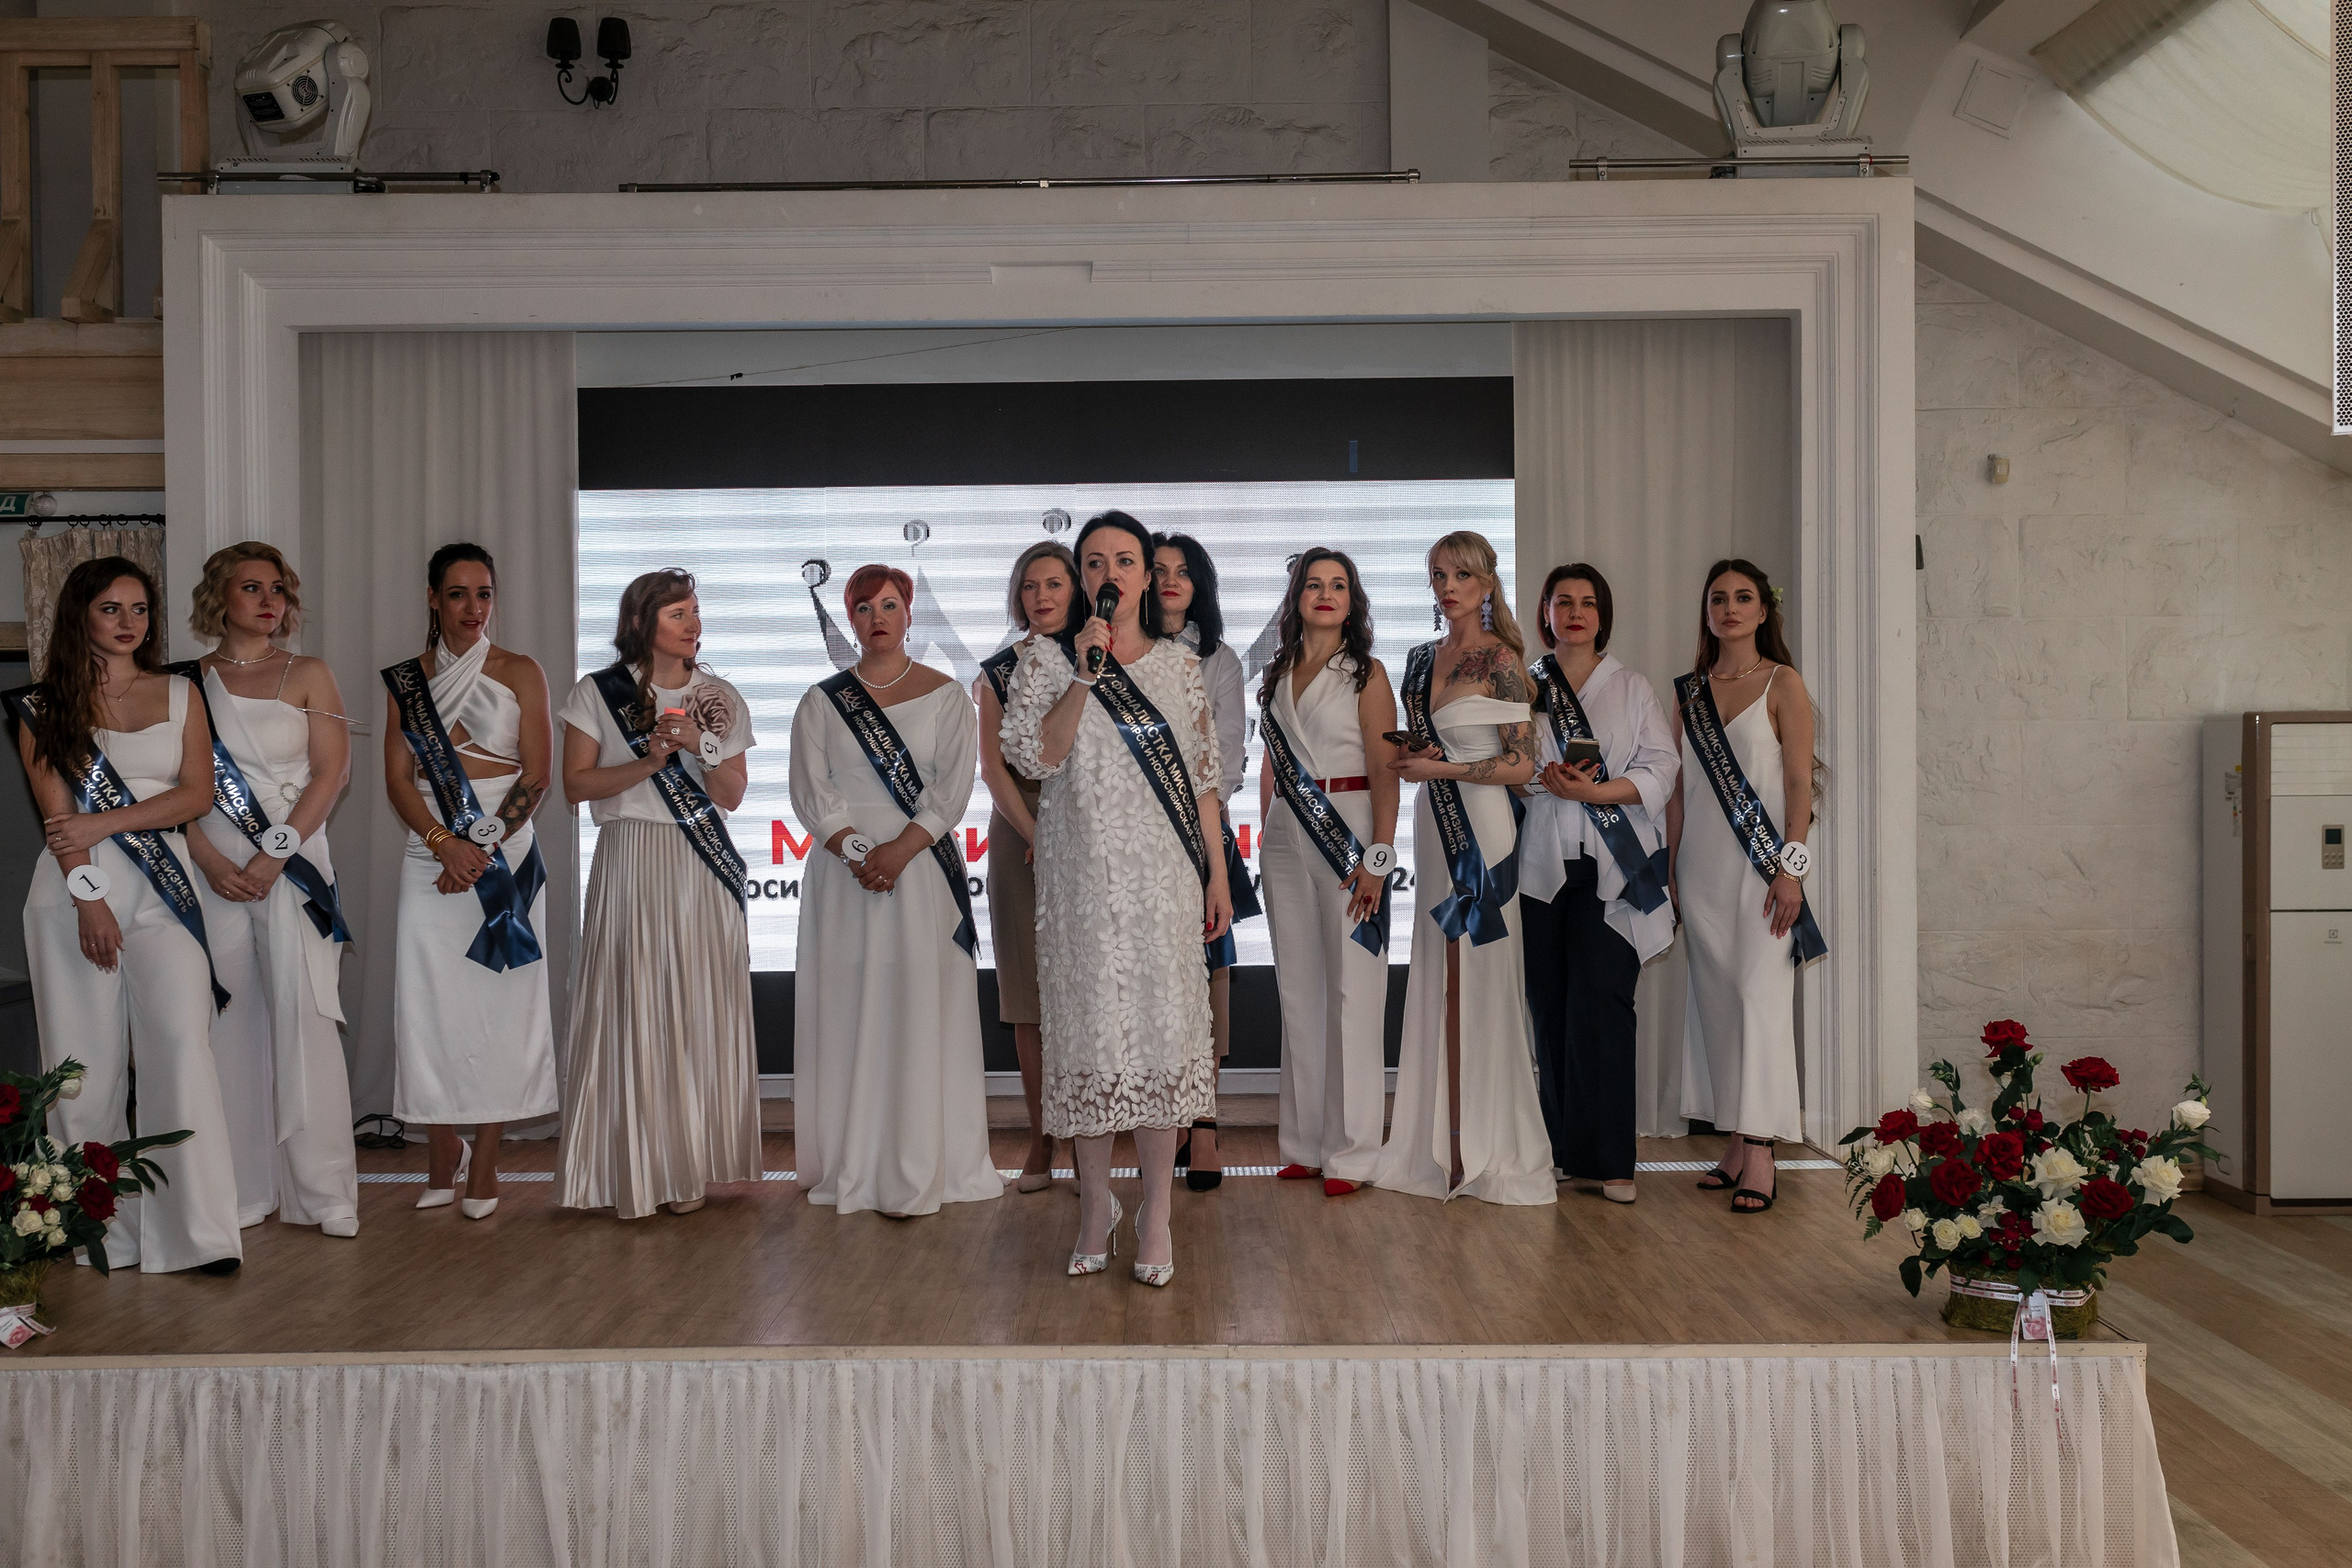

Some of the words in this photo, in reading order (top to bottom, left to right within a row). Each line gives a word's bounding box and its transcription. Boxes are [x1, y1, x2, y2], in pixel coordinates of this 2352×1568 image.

[705, 741, 718, 755] 5
[853, 715, 891, 770] НОВОСИБИРСК
[864, 710, 910, 783] ФИНАЛИСТКА
[1100, 684, 1148, 749] НОВОСИБИРСК
[1144, 748, 1154, 757] И
[1149, 756, 1193, 837] НОВОСИБИРСКАЯ
[1112, 680, 1173, 765] ФИНАЛИСТКА
[1168, 762, 1195, 819] МИССИС
[1696, 700, 1732, 776] ФИНАЛИСТКА
[1726, 773, 1760, 825] МИССИС
[223, 778, 259, 833] МИССИС
[430, 761, 467, 836] НОВОСИБИРСКАЯ
[447, 770, 476, 824] МИССИС
[1282, 777, 1329, 842] НОВОСИБИРСКАЯ
[1296, 782, 1333, 829] МИССИС
[1689, 705, 1714, 761] НОВОСИБИРСК
[1713, 767, 1754, 839] НОВОСИБИРСКАЯ
[1750, 837, 1777, 875] ОБЛАСТЬ
[274, 832, 288, 851] 2
[478, 824, 497, 837] 3
[676, 801, 723, 866] НОВОСИБИРСКАЯ
[720, 863, 745, 897] ОБЛАСТЬ
[694, 807, 722, 852] МИССИС
[1442, 815, 1458, 855] ОБЛАСТЬ
[1446, 803, 1469, 852] БИЗНЕС
[79, 874, 101, 893] 1
[159, 858, 196, 907] БИЗНЕС
[1373, 851, 1387, 867] 9
[1783, 846, 1807, 872] 13
[157, 873, 187, 913] ОБЛАСТЬ
